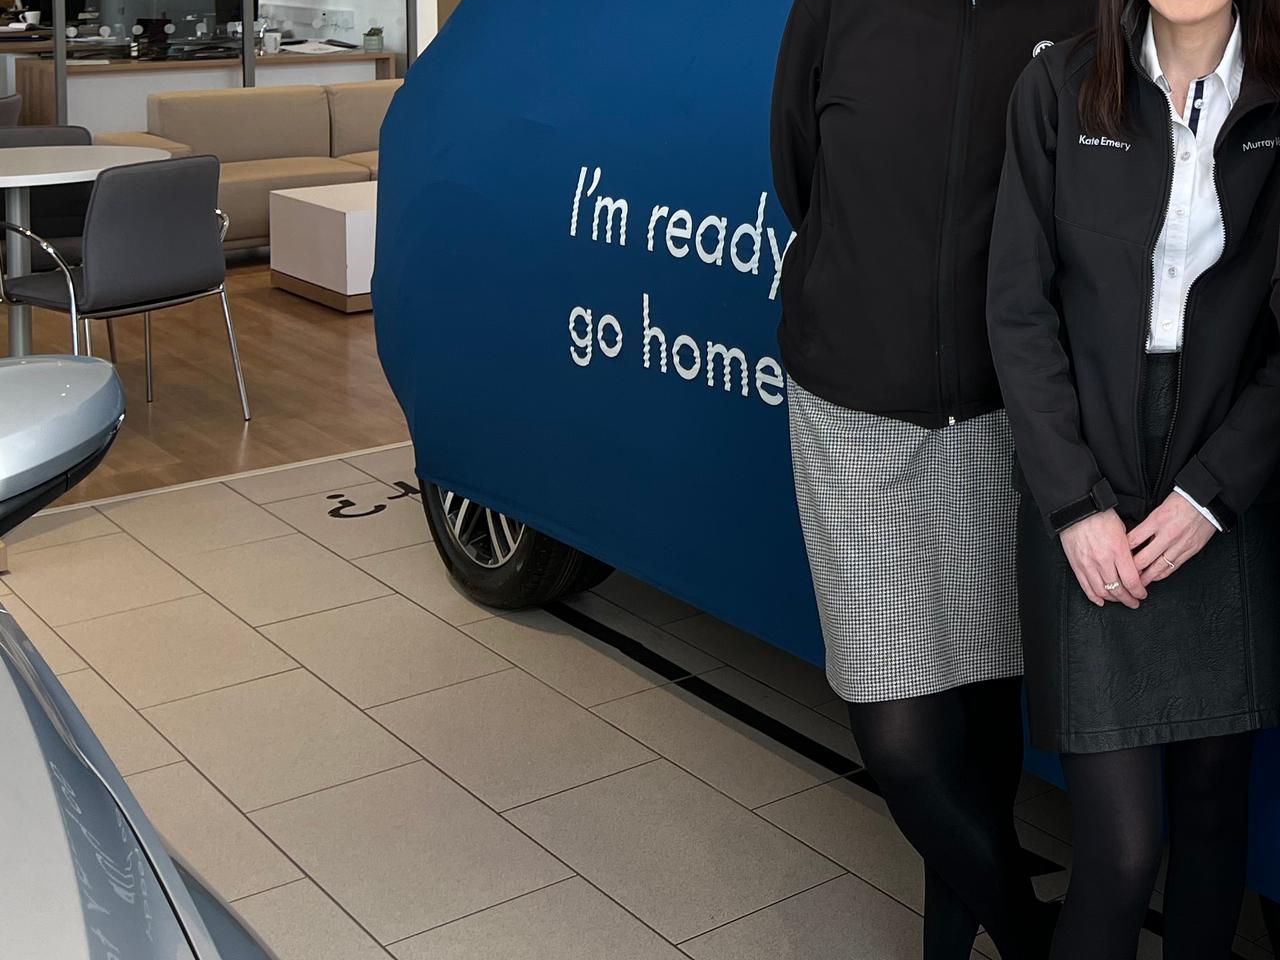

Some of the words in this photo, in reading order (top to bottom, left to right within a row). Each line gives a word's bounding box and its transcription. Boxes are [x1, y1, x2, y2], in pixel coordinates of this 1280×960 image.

[1079, 134, 1100, 146] Kate
[1100, 136, 1131, 151] Emery
[1242, 140, 1275, 152] Murray
[569, 166, 629, 246] I'm
[646, 191, 798, 300] ready
[568, 306, 623, 367] go
[643, 292, 785, 406] home
